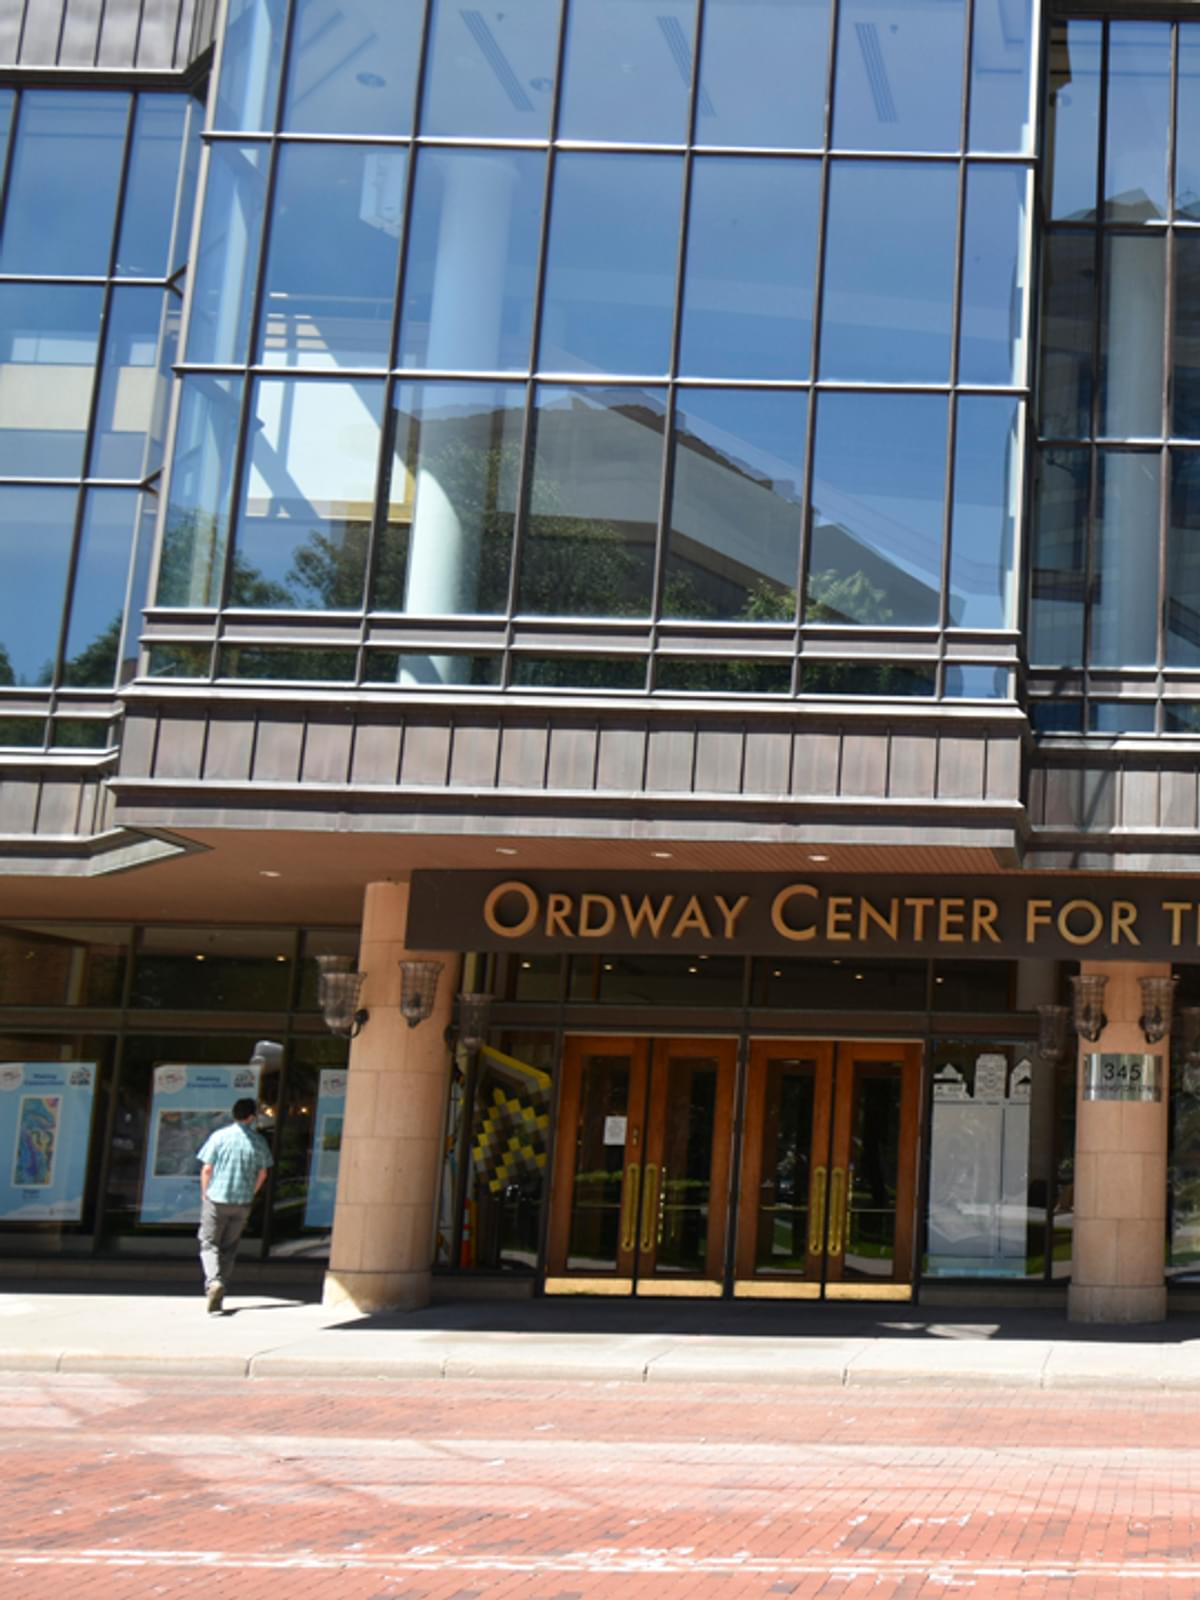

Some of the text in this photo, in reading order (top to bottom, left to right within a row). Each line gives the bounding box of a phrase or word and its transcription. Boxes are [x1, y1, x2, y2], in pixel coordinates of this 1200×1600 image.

[484, 881, 748, 938] ORDWAY
[771, 884, 1001, 942] CENTER
[1026, 900, 1141, 945] FOR
[1104, 1062, 1142, 1081] 345
